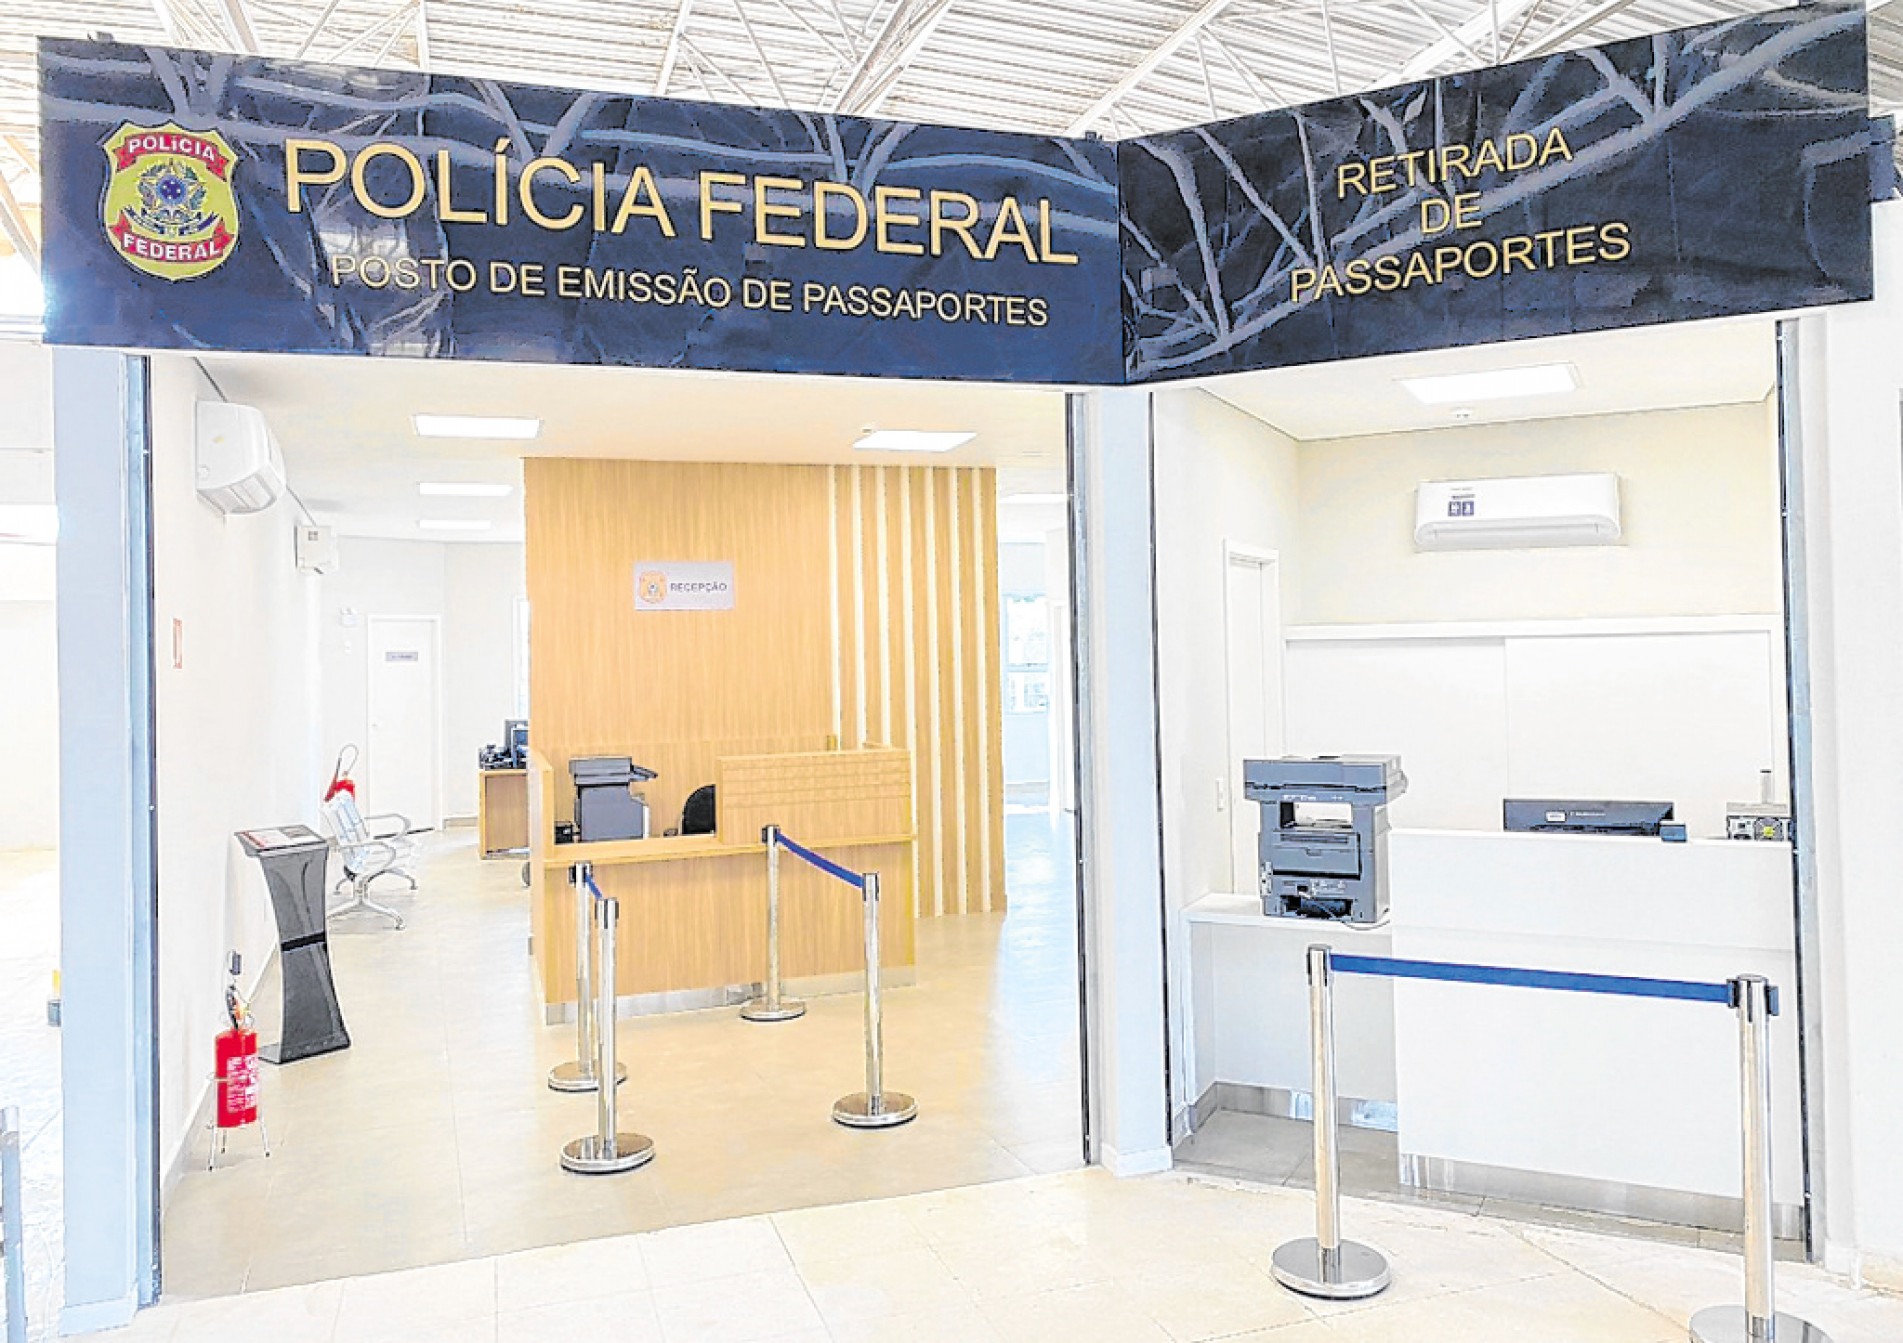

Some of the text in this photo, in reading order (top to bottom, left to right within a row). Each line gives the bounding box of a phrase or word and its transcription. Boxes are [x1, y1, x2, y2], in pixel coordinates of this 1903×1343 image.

[1336, 127, 1574, 199] RETIRADA
[284, 138, 1080, 266] POLÍCIA FEDERAL
[1418, 191, 1483, 235] DE
[123, 233, 220, 260] FEDERAL
[1289, 221, 1632, 303] PASSAPORTES
[331, 254, 1049, 327] POSTO DE EMISSÃO DE PASSAPORTES
[670, 581, 728, 593] RECEPÇÃO
